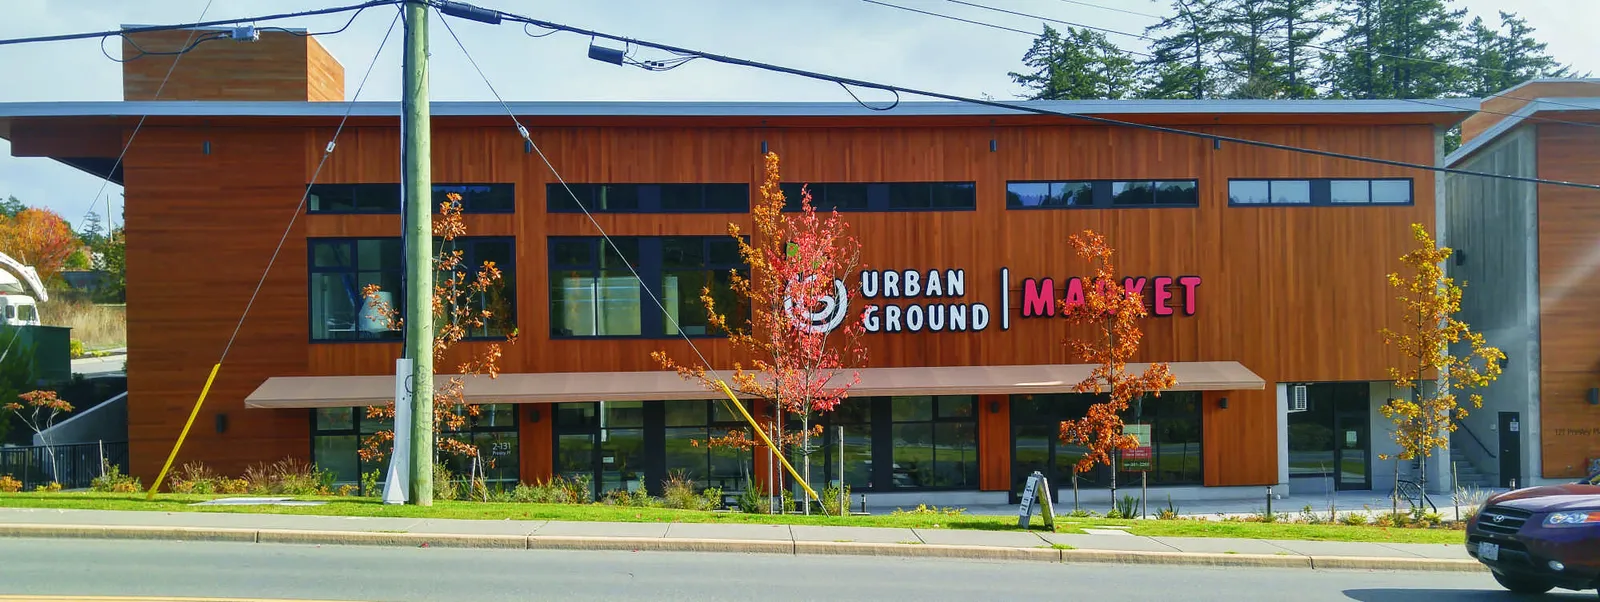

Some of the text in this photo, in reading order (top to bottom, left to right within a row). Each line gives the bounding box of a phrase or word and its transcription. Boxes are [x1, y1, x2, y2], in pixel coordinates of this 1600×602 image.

[861, 269, 965, 298] URBAN
[863, 303, 990, 332] GROUND
[492, 442, 511, 450] 2-131
